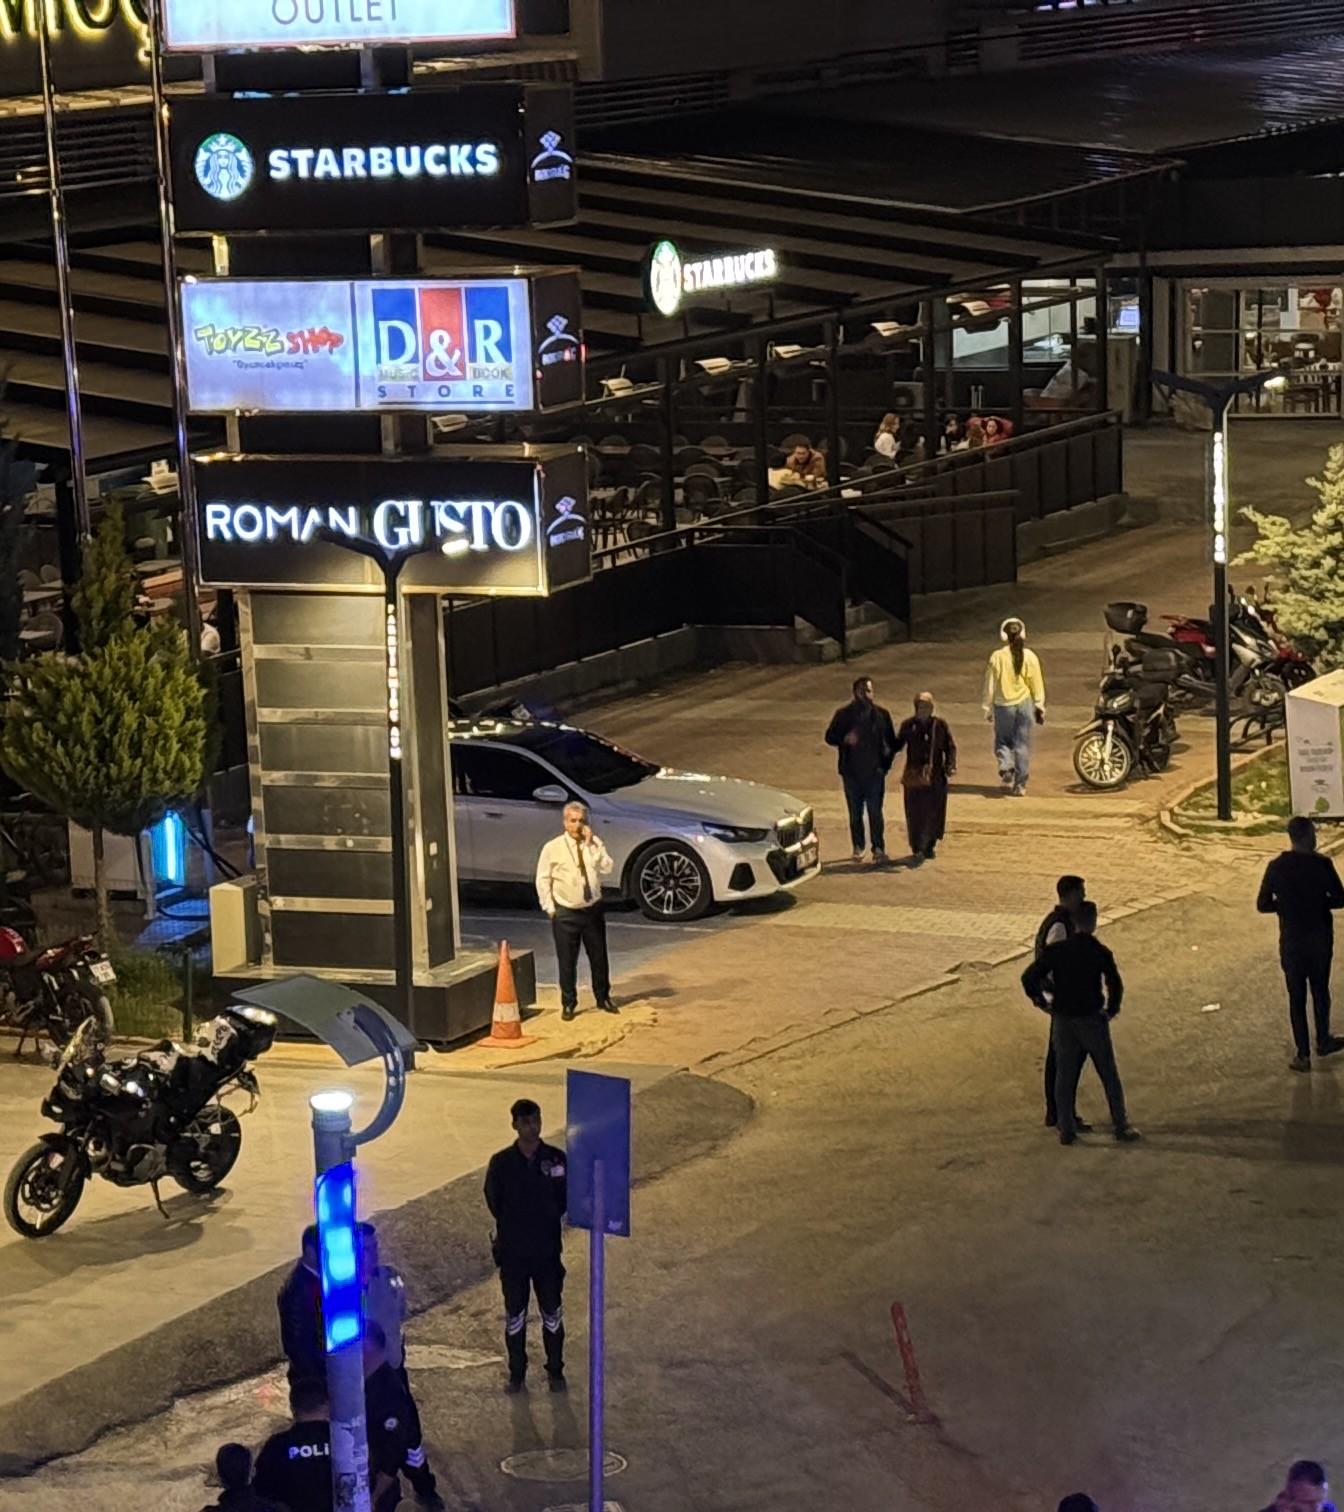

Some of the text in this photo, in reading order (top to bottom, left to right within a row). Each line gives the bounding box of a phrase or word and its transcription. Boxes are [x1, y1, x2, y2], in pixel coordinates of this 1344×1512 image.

[268, 143, 498, 180] STARBUCKS
[683, 248, 777, 293] STARBUCKS
[378, 319, 512, 377] D&R
[377, 383, 515, 398] STORE
[206, 504, 357, 542] ROMAN
[373, 500, 532, 551] GUSTO
[288, 1442, 330, 1460] POLİ
